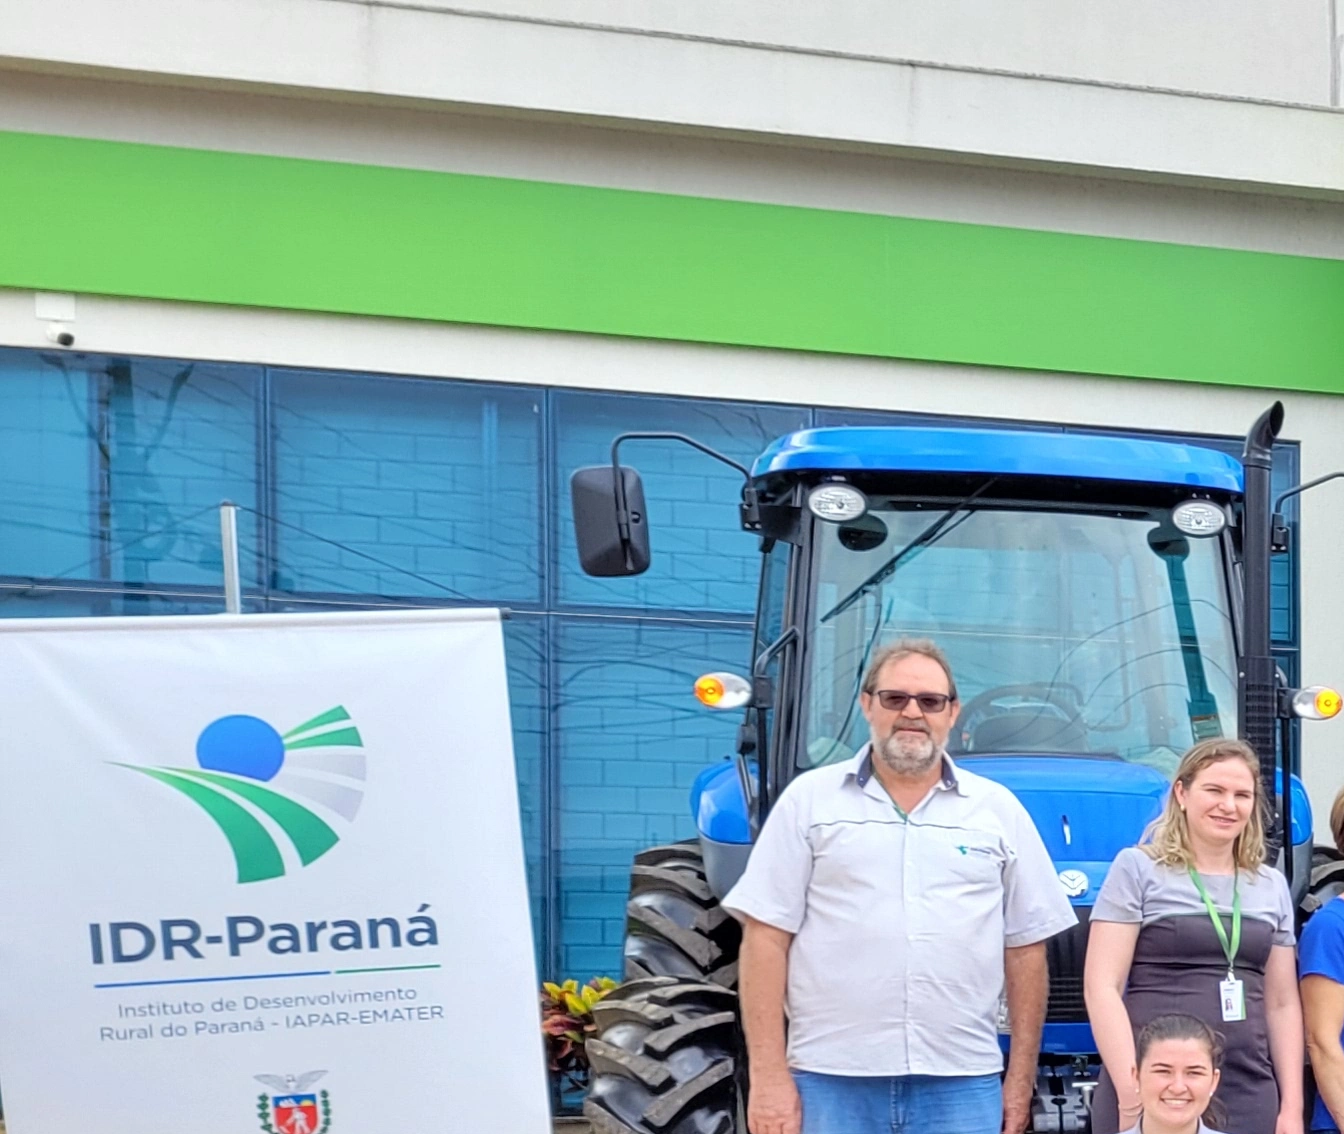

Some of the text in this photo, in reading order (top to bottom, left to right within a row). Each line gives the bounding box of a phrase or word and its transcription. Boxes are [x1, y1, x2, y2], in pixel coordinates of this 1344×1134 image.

[89, 903, 440, 965] IDR-Paraná
[118, 988, 417, 1019] Instituto de Desenvolvimento
[100, 1024, 154, 1042] Rural
[160, 1023, 188, 1038] do
[194, 1016, 265, 1036] Paraná
[285, 1005, 444, 1029] IAPAR-EMATER
